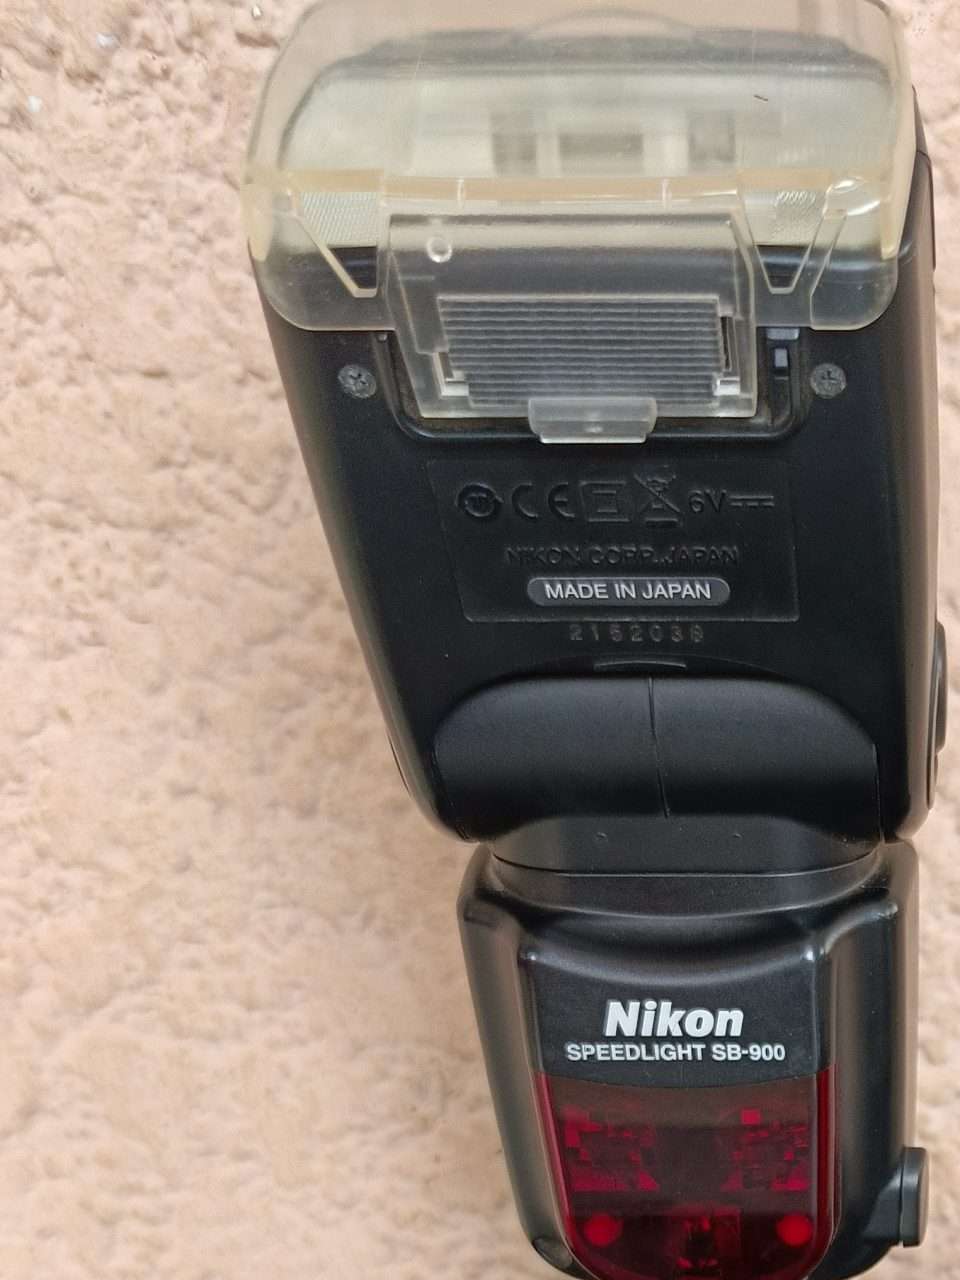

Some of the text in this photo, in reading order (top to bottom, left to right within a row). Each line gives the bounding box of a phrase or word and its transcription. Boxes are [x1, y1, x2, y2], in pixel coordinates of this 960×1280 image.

[503, 546, 581, 565] NIKON
[544, 582, 711, 599] MADE IN JAPAN
[604, 1000, 745, 1037] Nikon
[566, 1043, 786, 1062] SPEEDLIGHT SB-900
